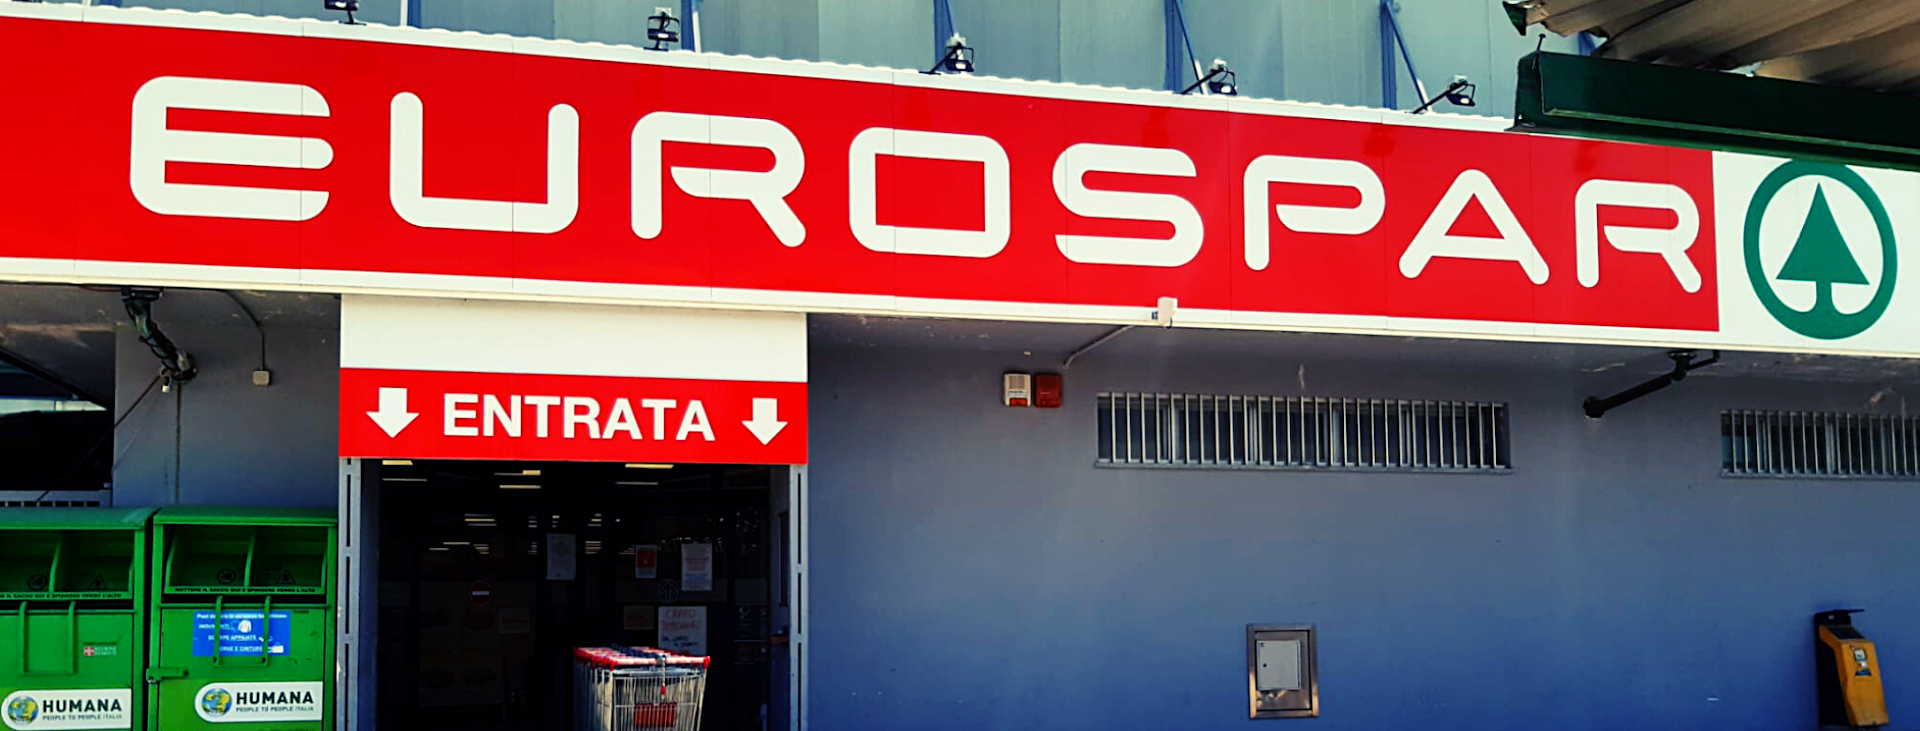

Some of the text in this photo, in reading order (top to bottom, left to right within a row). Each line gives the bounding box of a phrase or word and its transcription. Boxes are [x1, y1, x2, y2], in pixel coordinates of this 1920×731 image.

[130, 76, 1701, 293] EUROSPAR
[443, 393, 715, 441] ENTRATA
[42, 698, 122, 713] HUMANA
[236, 691, 314, 705] HUMANA
